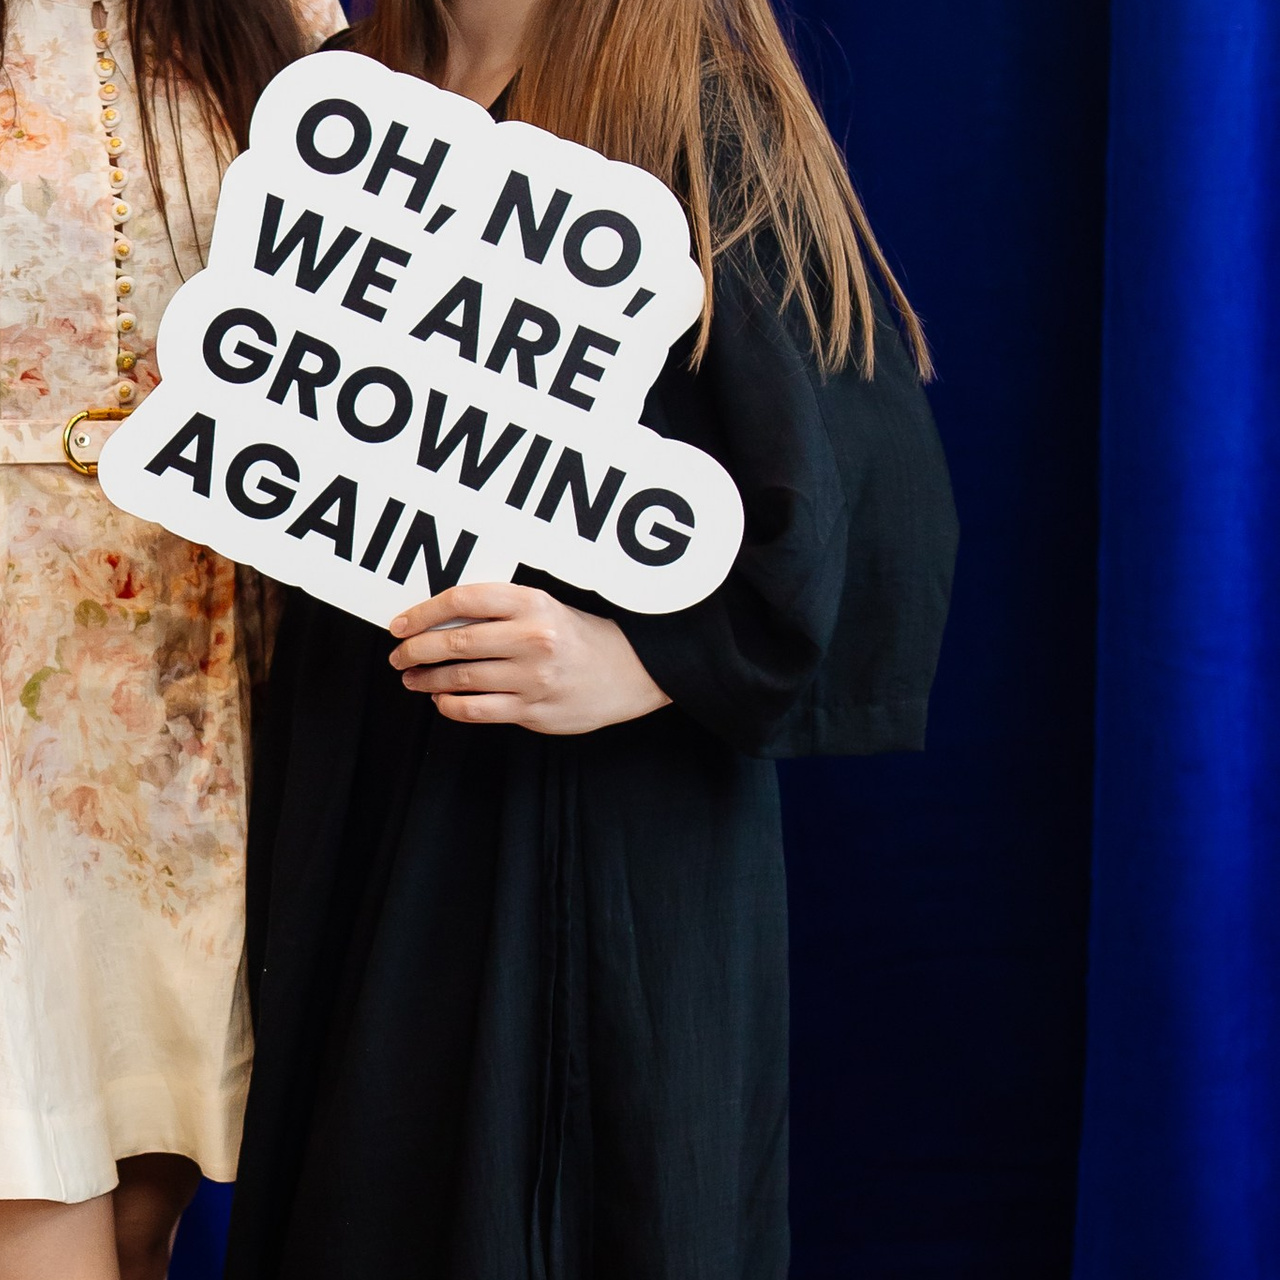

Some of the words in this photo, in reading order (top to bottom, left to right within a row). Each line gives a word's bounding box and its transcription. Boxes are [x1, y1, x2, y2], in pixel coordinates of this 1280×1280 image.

[253, 193, 412, 323] WE
[408, 276, 621, 412] ARE
[295, 97, 457, 233] OH,
[480, 170, 657, 319] NO,
[144, 411, 479, 598] AGAIN
[201, 307, 696, 567] GROWING
